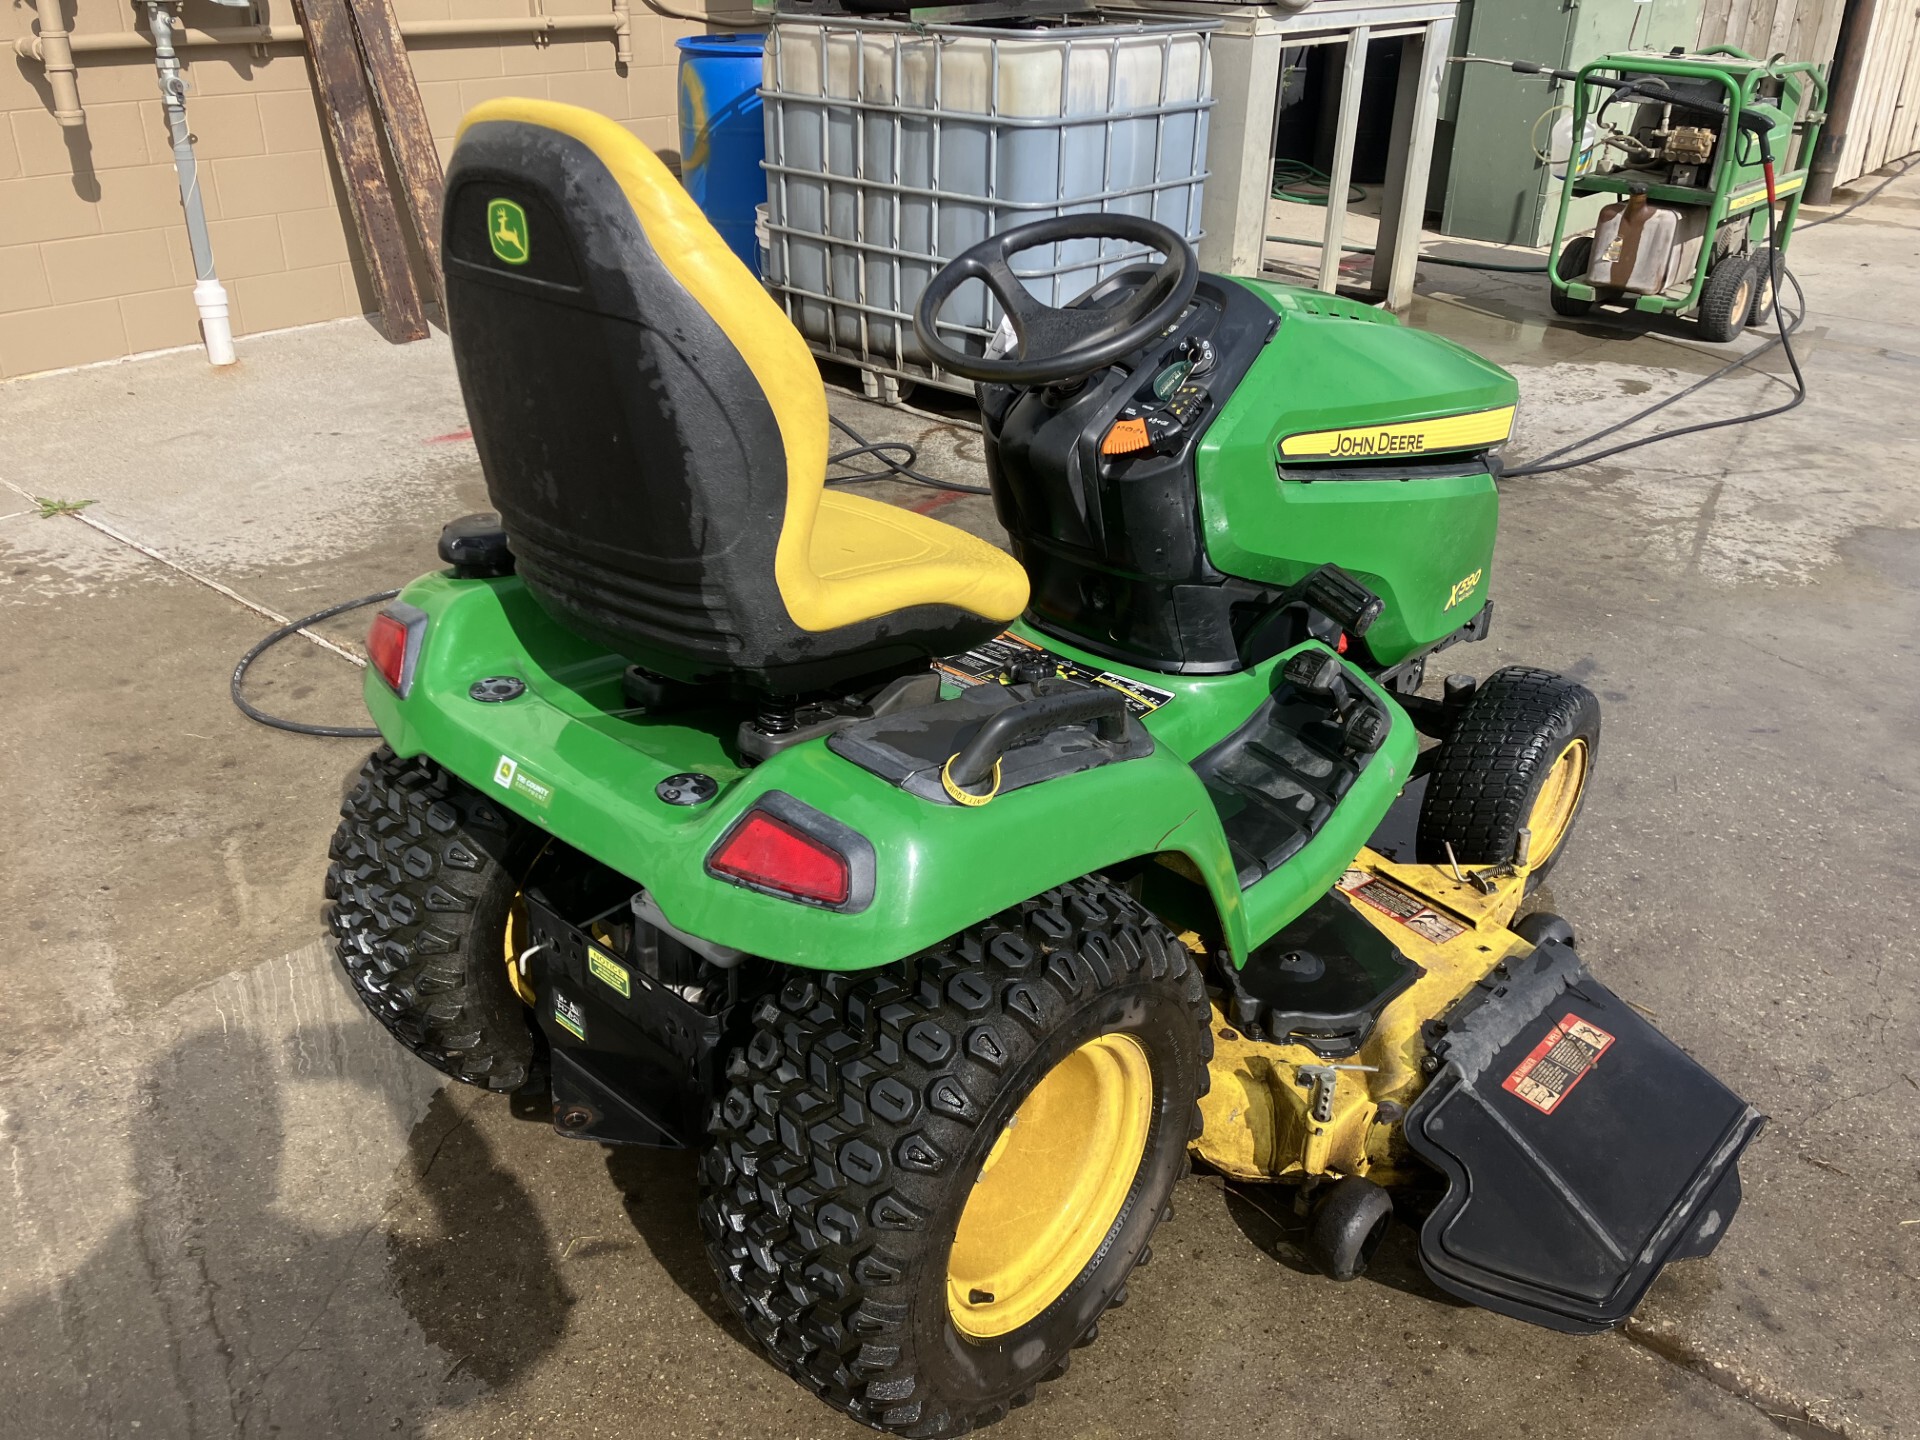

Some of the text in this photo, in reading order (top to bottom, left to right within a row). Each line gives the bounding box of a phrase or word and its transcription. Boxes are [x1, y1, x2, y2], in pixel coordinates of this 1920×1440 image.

[1330, 432, 1425, 453] JOHN DEERE
[525, 778, 550, 797] COUNTY
[947, 785, 966, 802] EQUIP
[593, 952, 624, 978] NOTICE
[1515, 1057, 1538, 1077] DANGER
